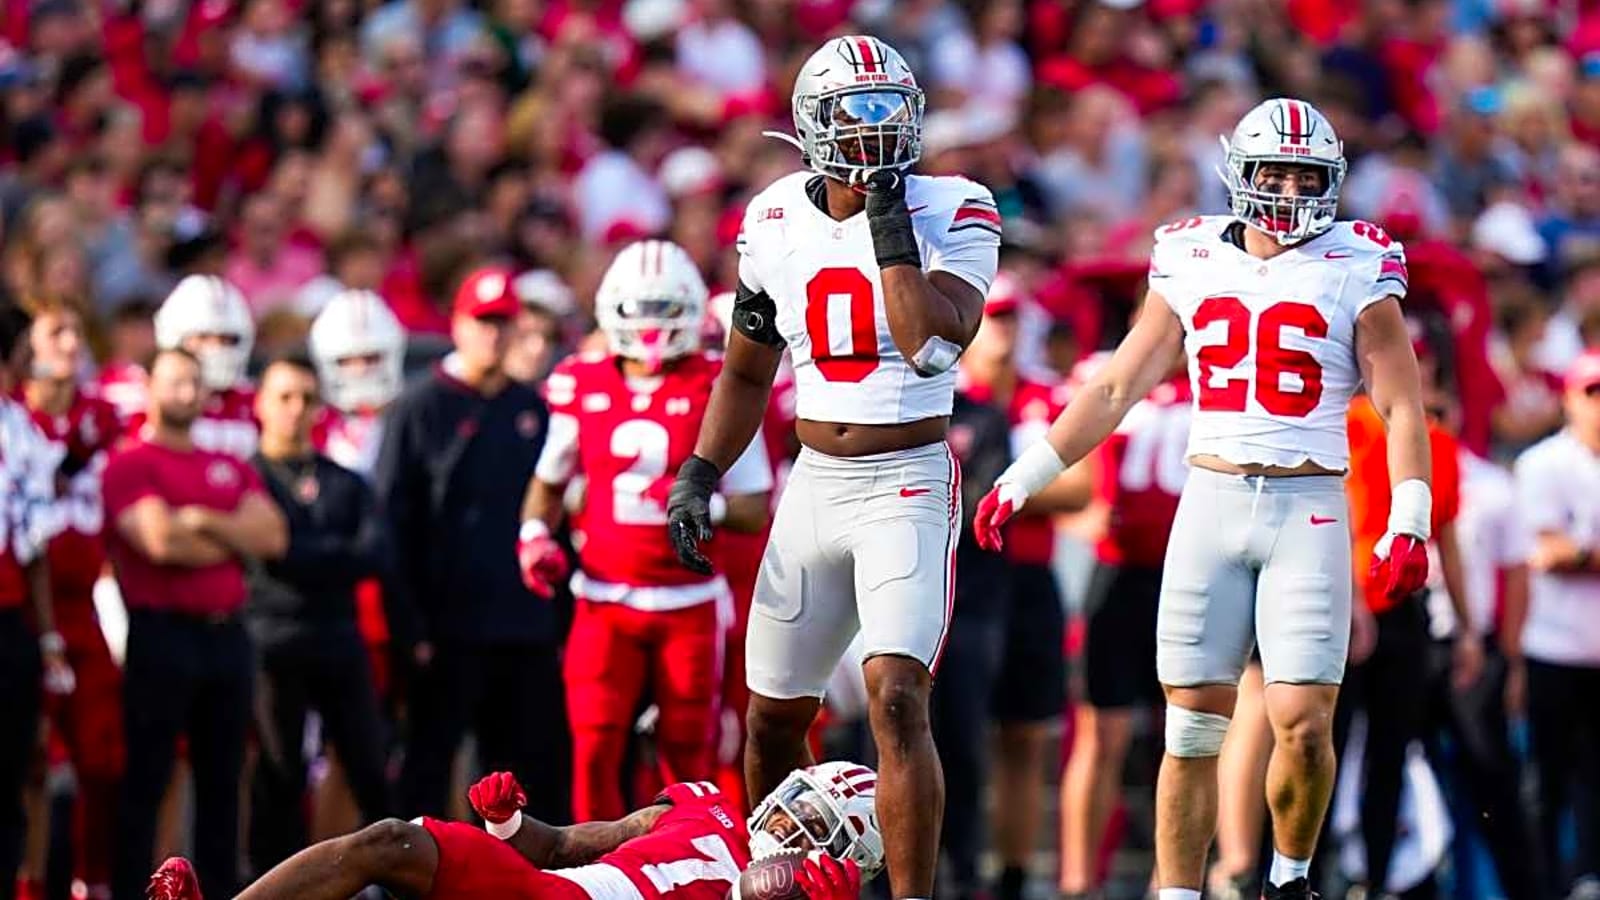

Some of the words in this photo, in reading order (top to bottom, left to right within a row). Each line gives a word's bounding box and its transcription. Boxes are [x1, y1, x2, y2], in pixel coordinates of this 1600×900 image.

[805, 266, 880, 383] 0
[1192, 296, 1329, 419] 26
[609, 418, 670, 526] 2
